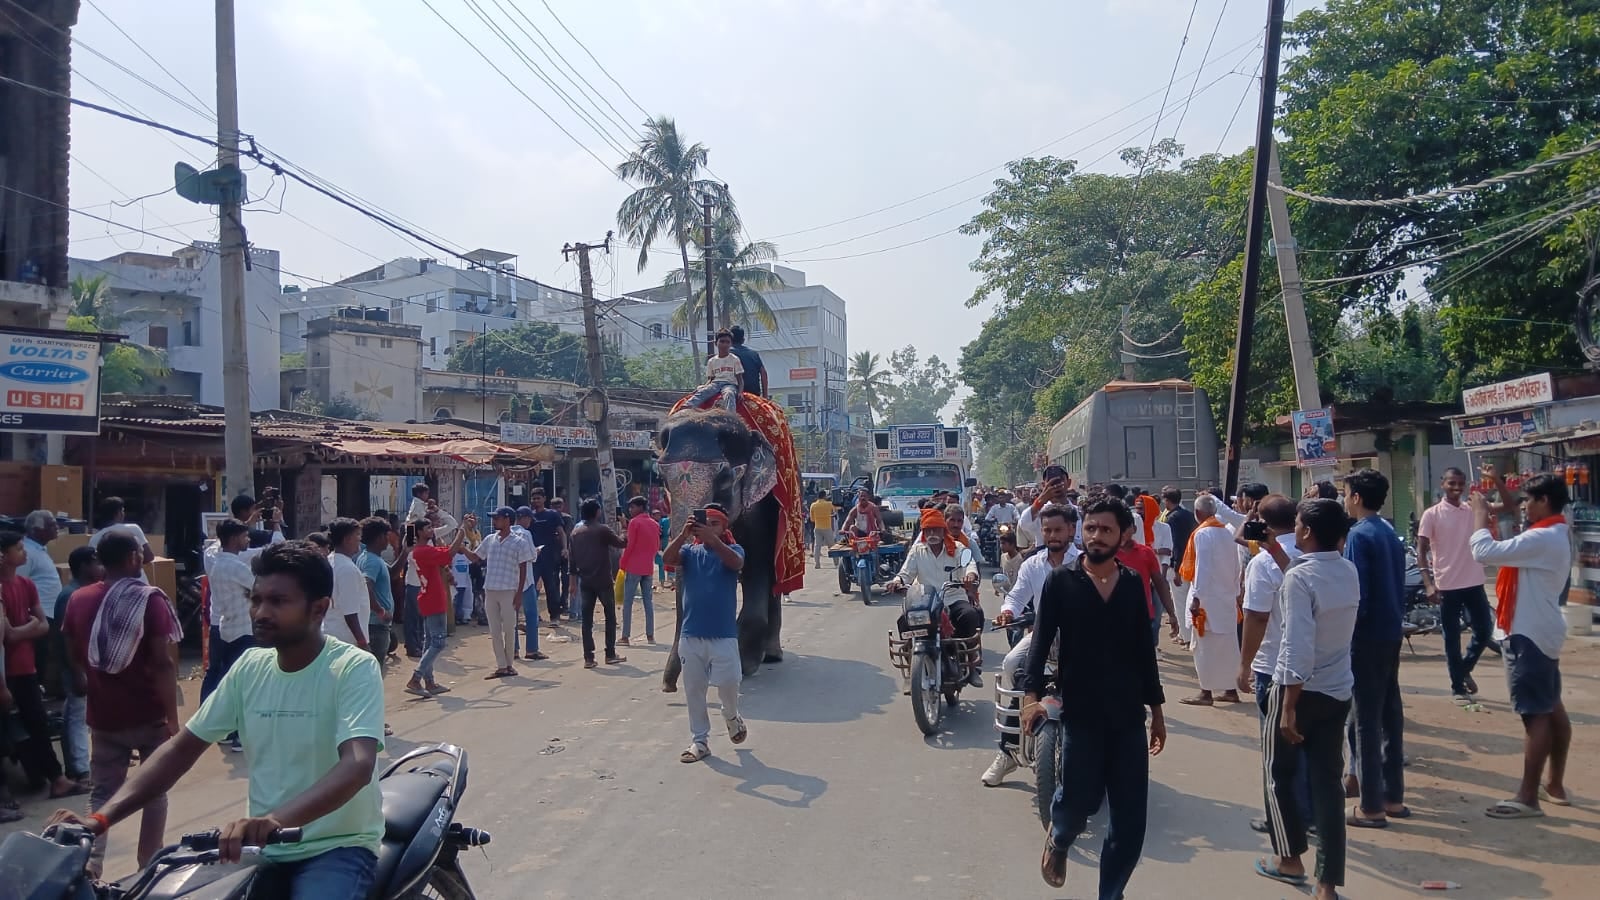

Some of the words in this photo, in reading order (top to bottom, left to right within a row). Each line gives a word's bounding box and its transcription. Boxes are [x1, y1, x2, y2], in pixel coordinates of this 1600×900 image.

[9, 345, 88, 361] VOLTAS
[10, 365, 79, 379] Carrier
[11, 392, 81, 407] USHA
